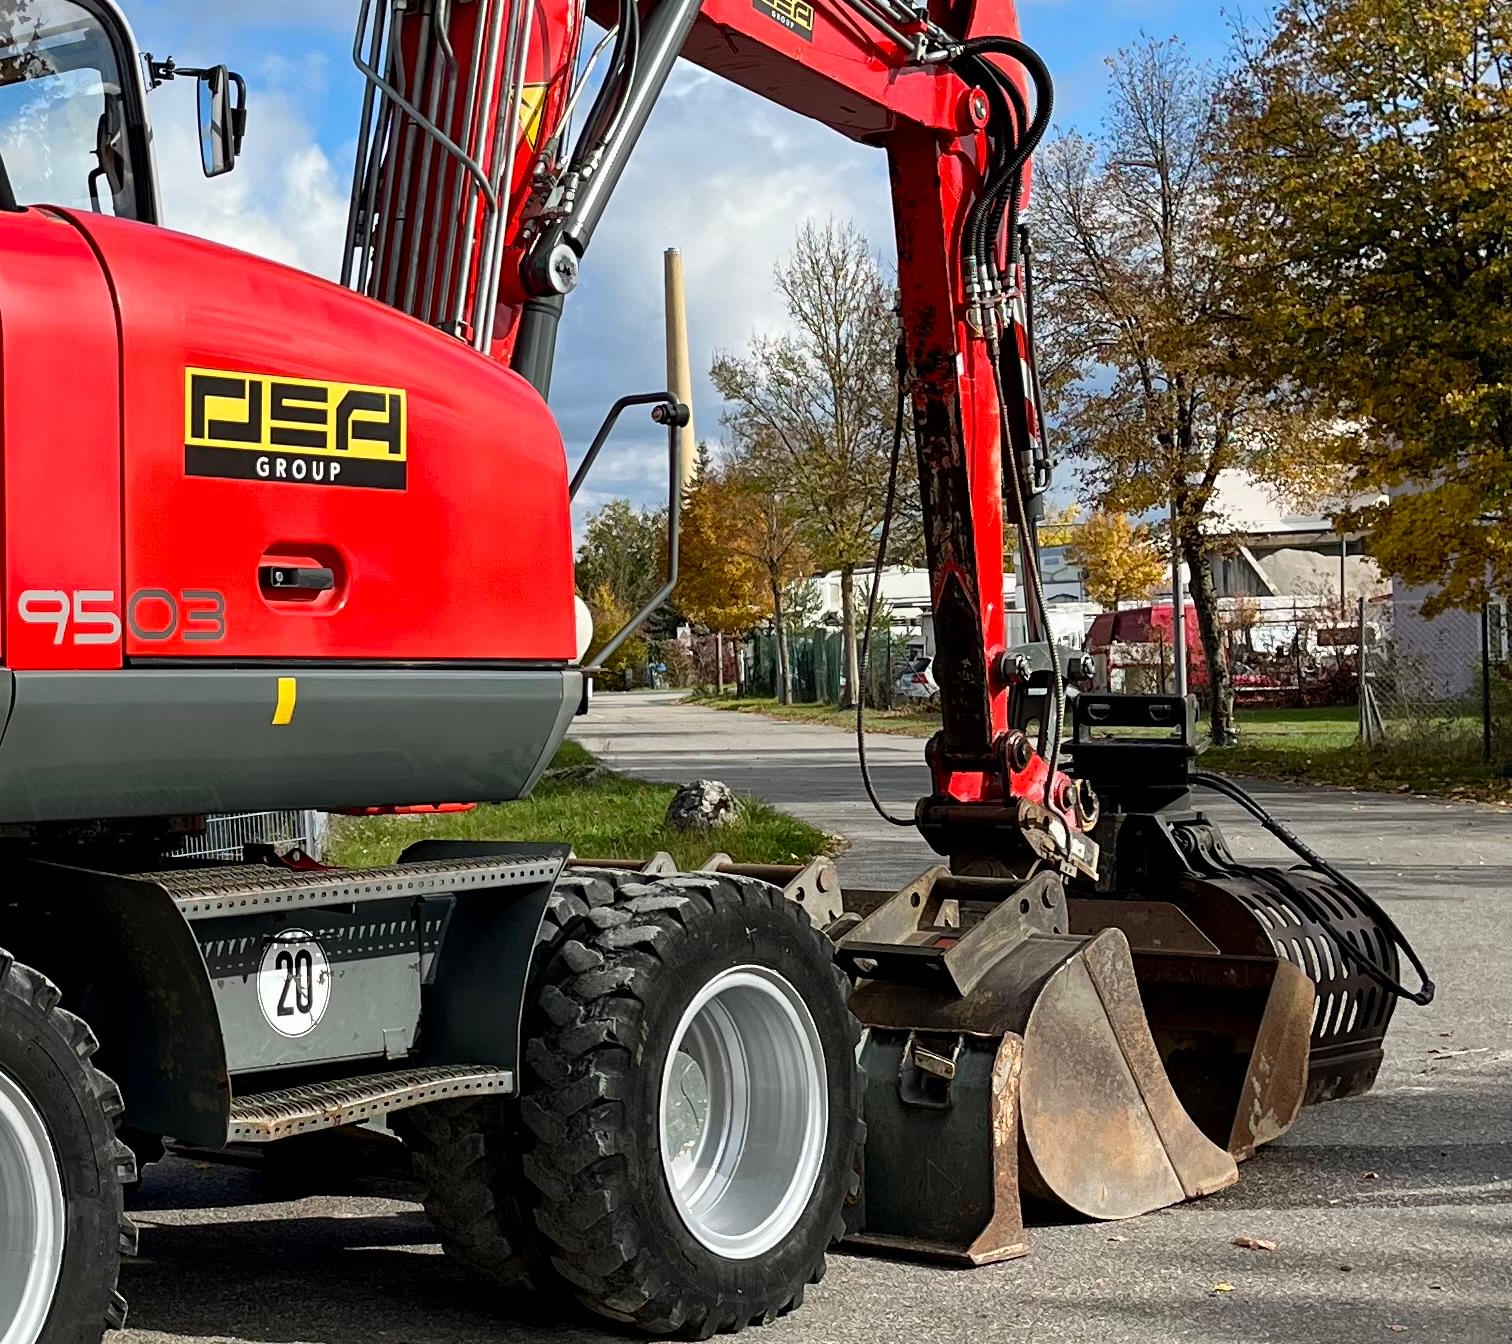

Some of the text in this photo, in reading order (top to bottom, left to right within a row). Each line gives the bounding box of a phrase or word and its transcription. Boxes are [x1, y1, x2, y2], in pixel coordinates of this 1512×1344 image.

[256, 456, 341, 481] GROUP
[18, 589, 225, 645] 9503
[275, 948, 313, 1017] 20
